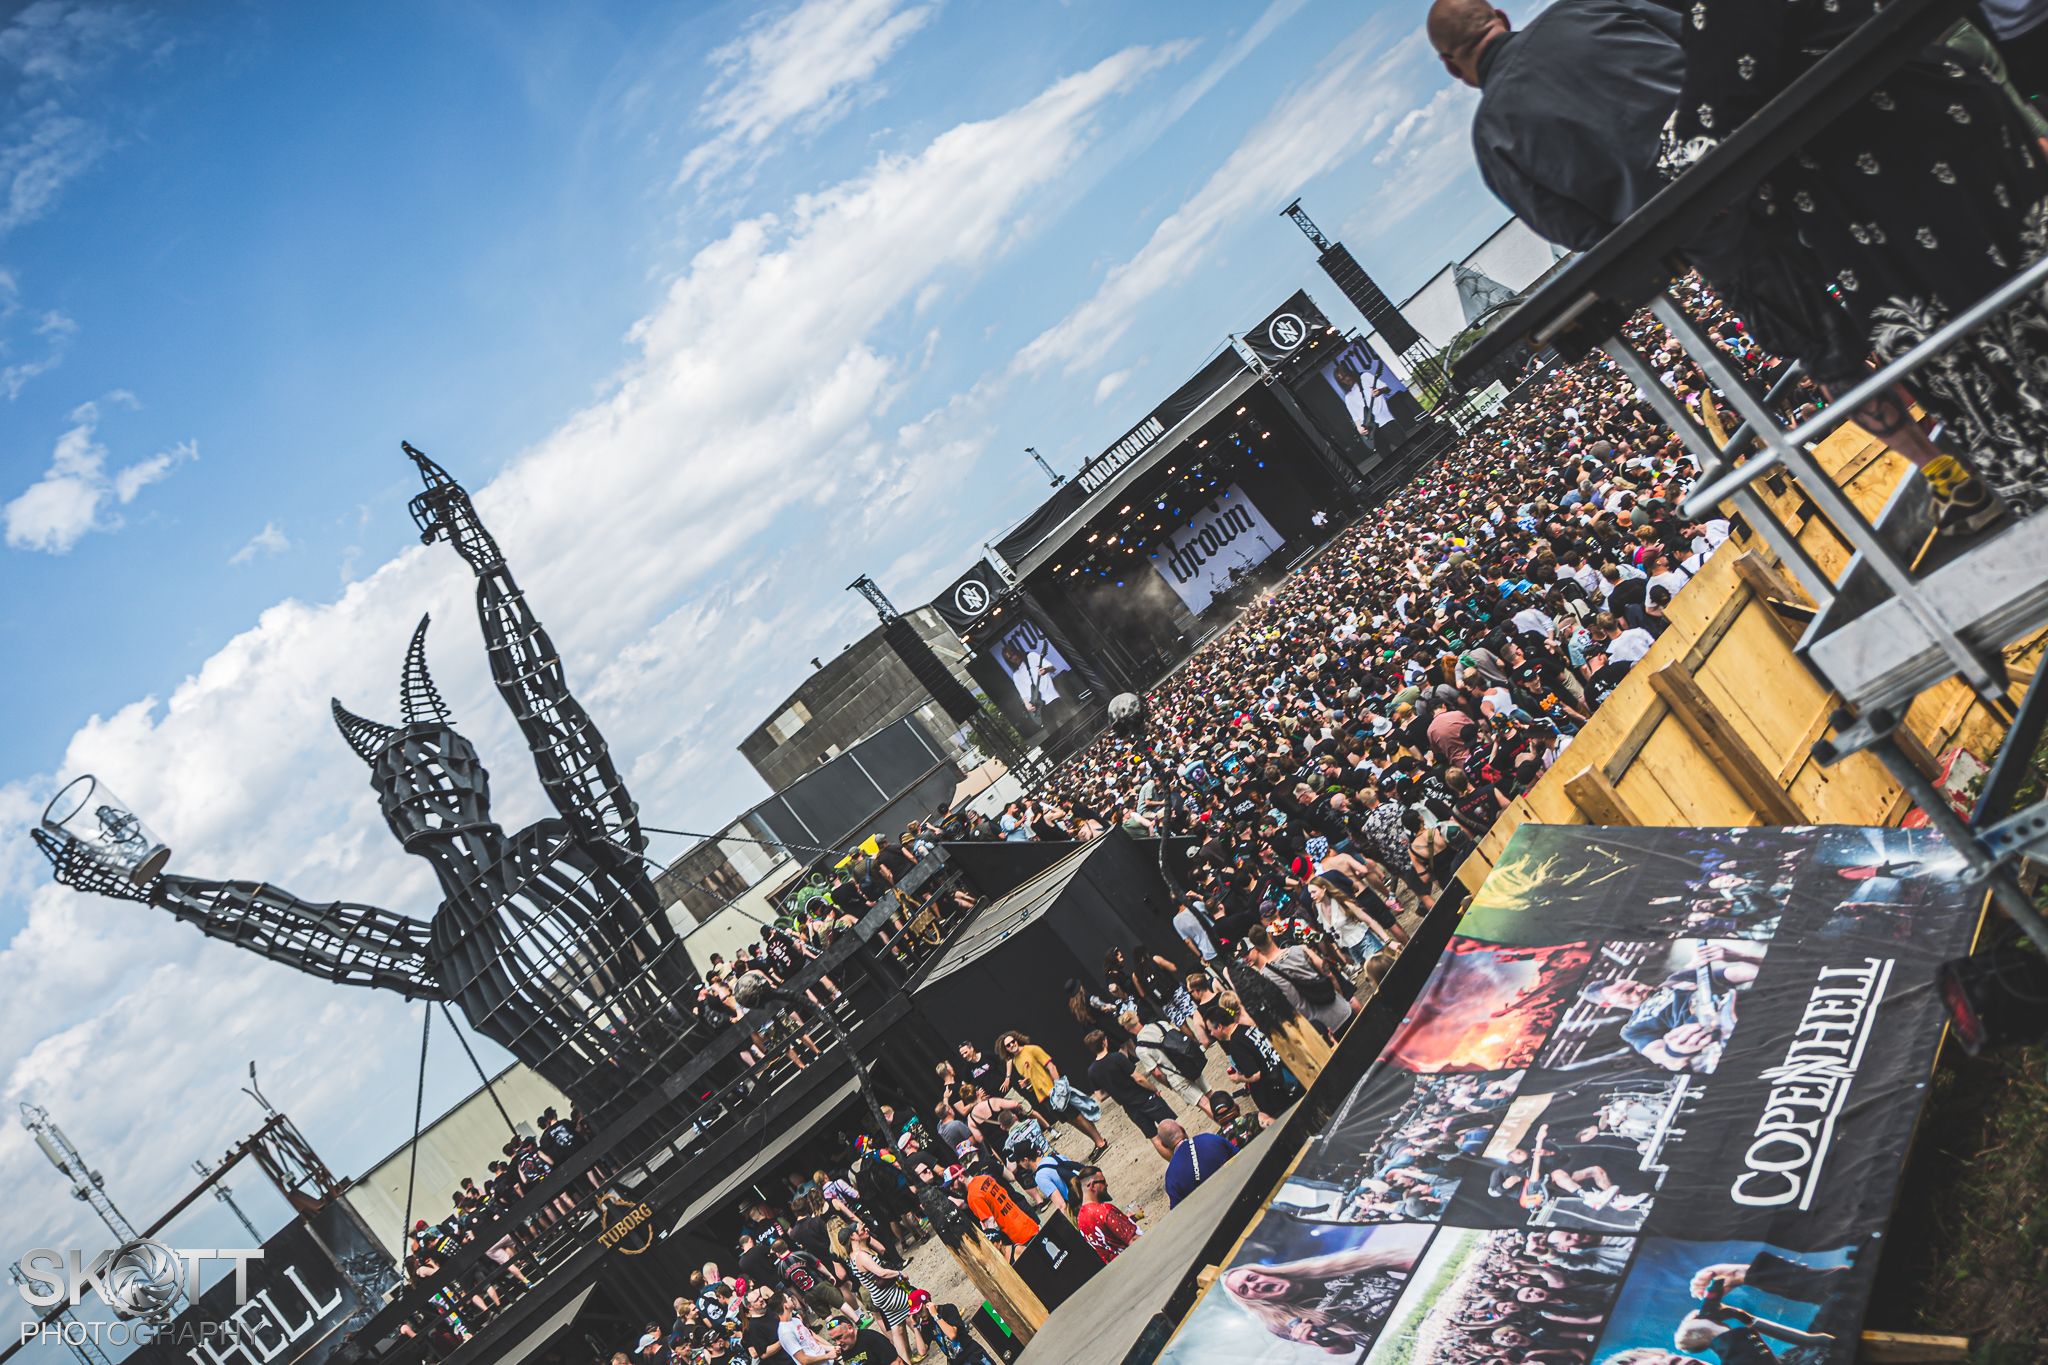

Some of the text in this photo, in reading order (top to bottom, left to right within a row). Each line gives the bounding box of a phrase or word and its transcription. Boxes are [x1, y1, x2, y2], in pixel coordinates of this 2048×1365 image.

[1165, 503, 1257, 585] thrown
[1731, 957, 1884, 1207] COPENHELL
[597, 1203, 653, 1249] TUBORG
